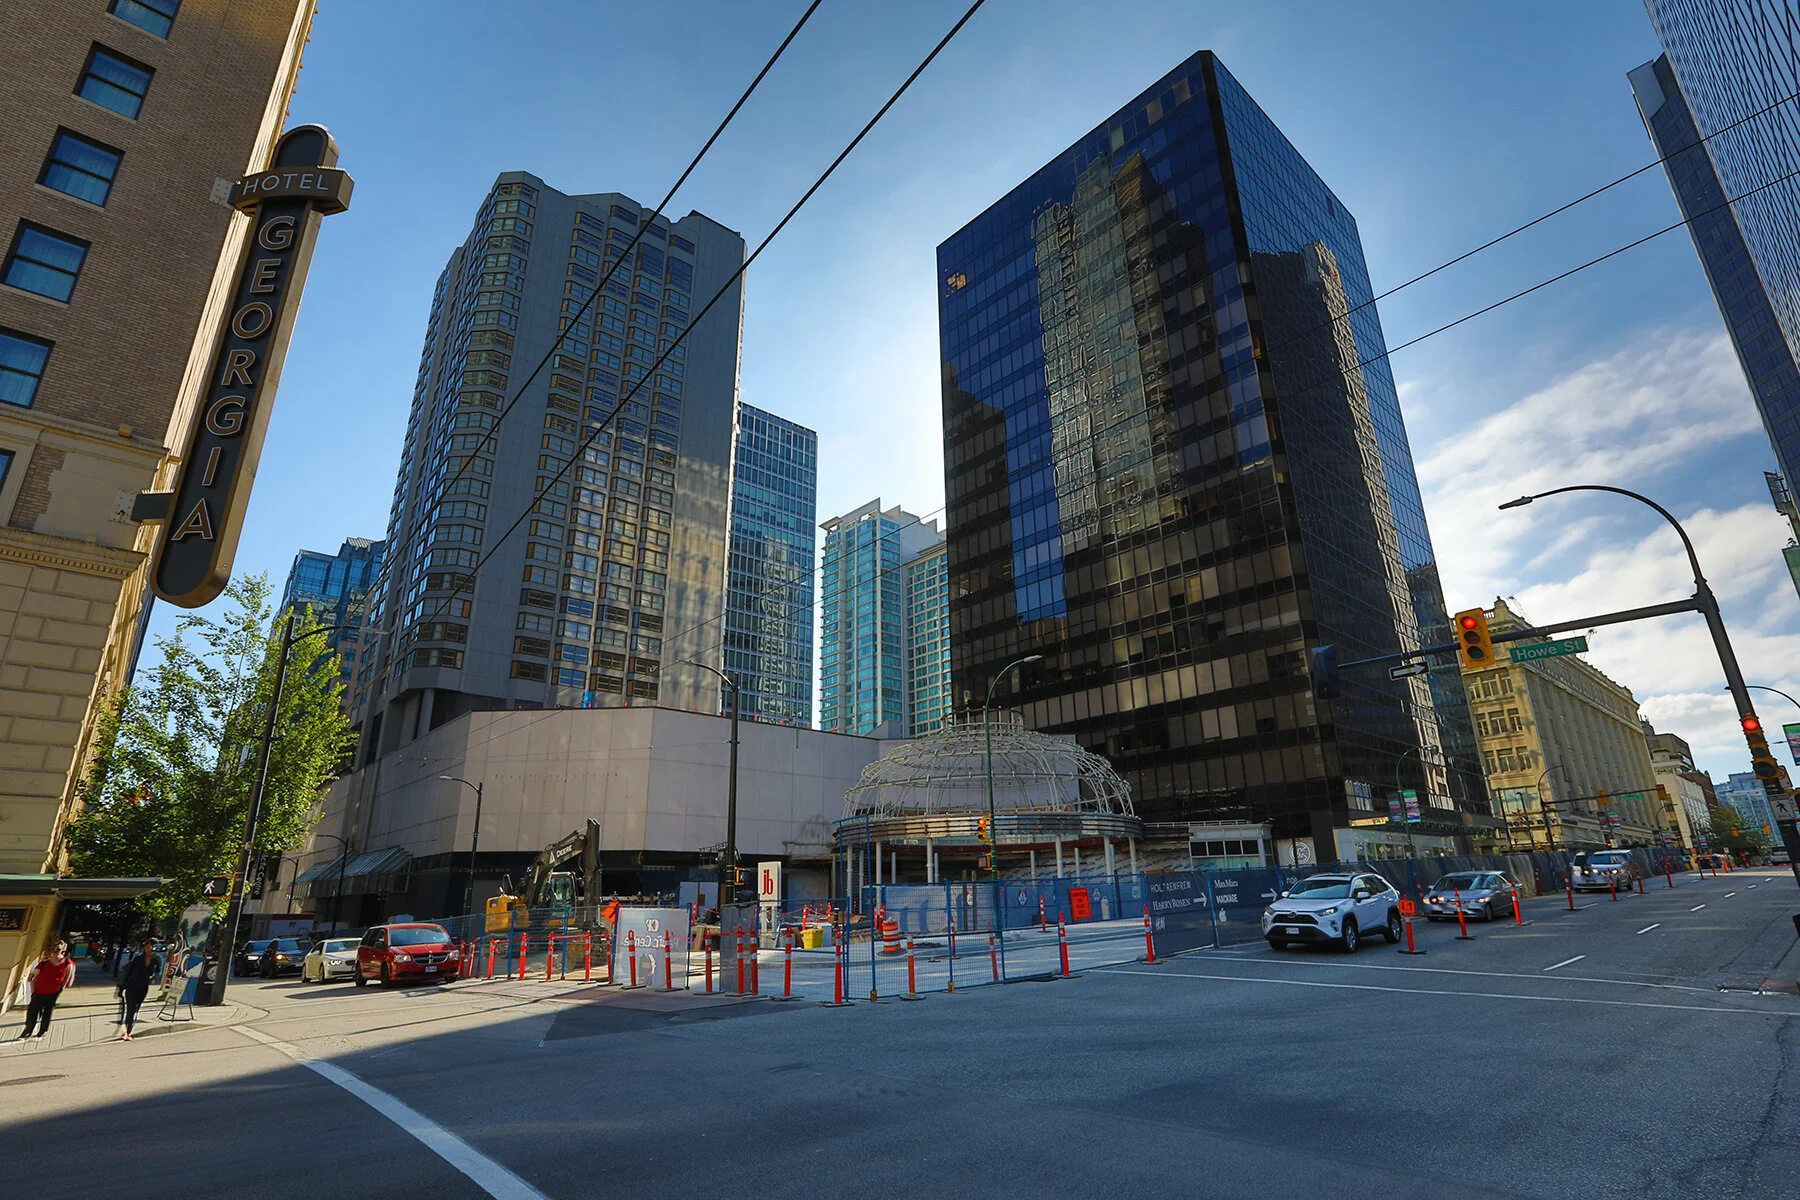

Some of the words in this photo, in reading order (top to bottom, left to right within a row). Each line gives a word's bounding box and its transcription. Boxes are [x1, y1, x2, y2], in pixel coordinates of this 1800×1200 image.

[242, 173, 329, 196] HOTEL
[171, 215, 296, 541] GEORGIA
[1516, 645, 1558, 661] Howe
[1563, 640, 1581, 652] St
[556, 844, 573, 858] DEERE
[762, 869, 774, 896] jb
